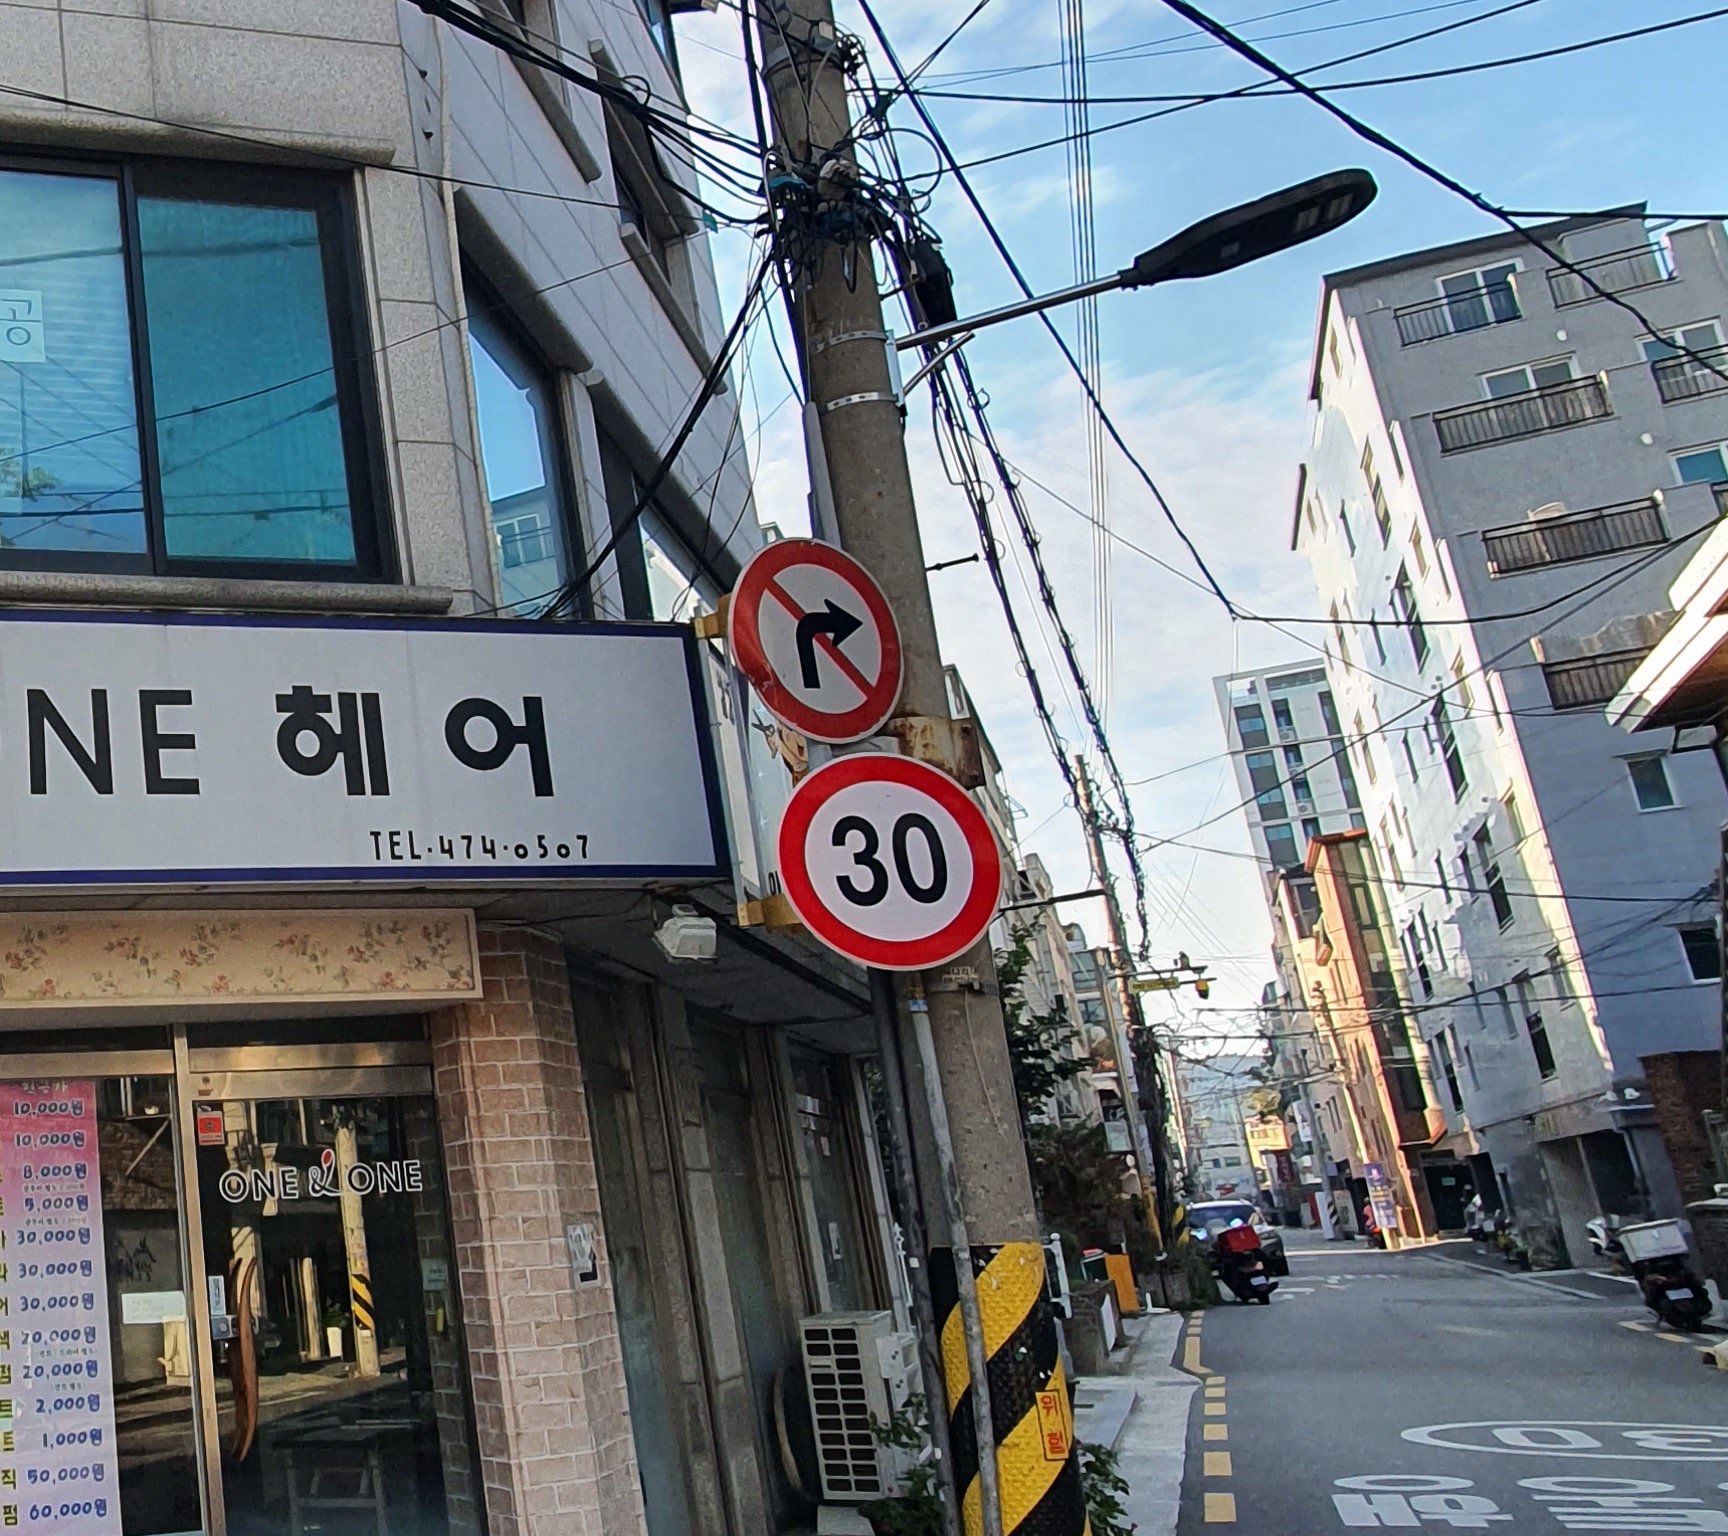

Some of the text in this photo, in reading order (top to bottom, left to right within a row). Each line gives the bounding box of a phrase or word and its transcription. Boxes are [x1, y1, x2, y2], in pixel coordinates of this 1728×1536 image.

[831, 812, 949, 906] 30
[14, 1099, 84, 1118] 10,000원
[15, 1131, 86, 1149] 10,000원
[23, 1162, 87, 1181] 8,000원
[219, 1166, 300, 1204] ONE
[345, 1159, 423, 1196] ONE
[22, 1359, 98, 1380] 20,000원
[35, 1393, 101, 1414] 2,000원
[1040, 1394, 1068, 1455] 위험
[42, 1428, 103, 1451] 1,000원
[27, 1462, 105, 1486] 50,000원
[29, 1497, 108, 1522] 60,000원
